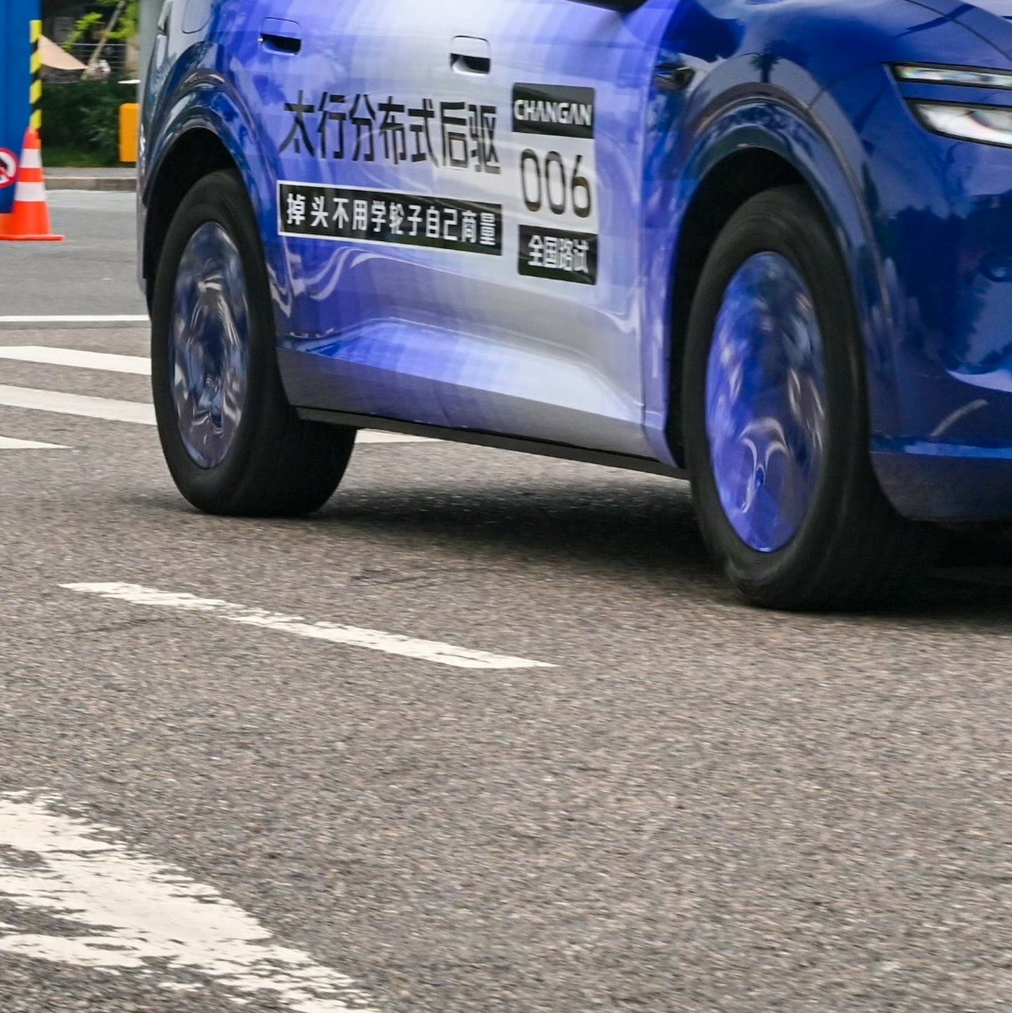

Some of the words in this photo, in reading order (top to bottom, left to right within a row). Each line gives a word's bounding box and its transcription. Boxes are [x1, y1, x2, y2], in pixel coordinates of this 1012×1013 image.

[278, 90, 501, 175] 太行分布式后驱
[513, 99, 592, 127] CHANGAN
[520, 148, 592, 219] 006
[286, 192, 497, 247] 掉头不用学轮子自己商量
[527, 234, 590, 274] 全国路试
